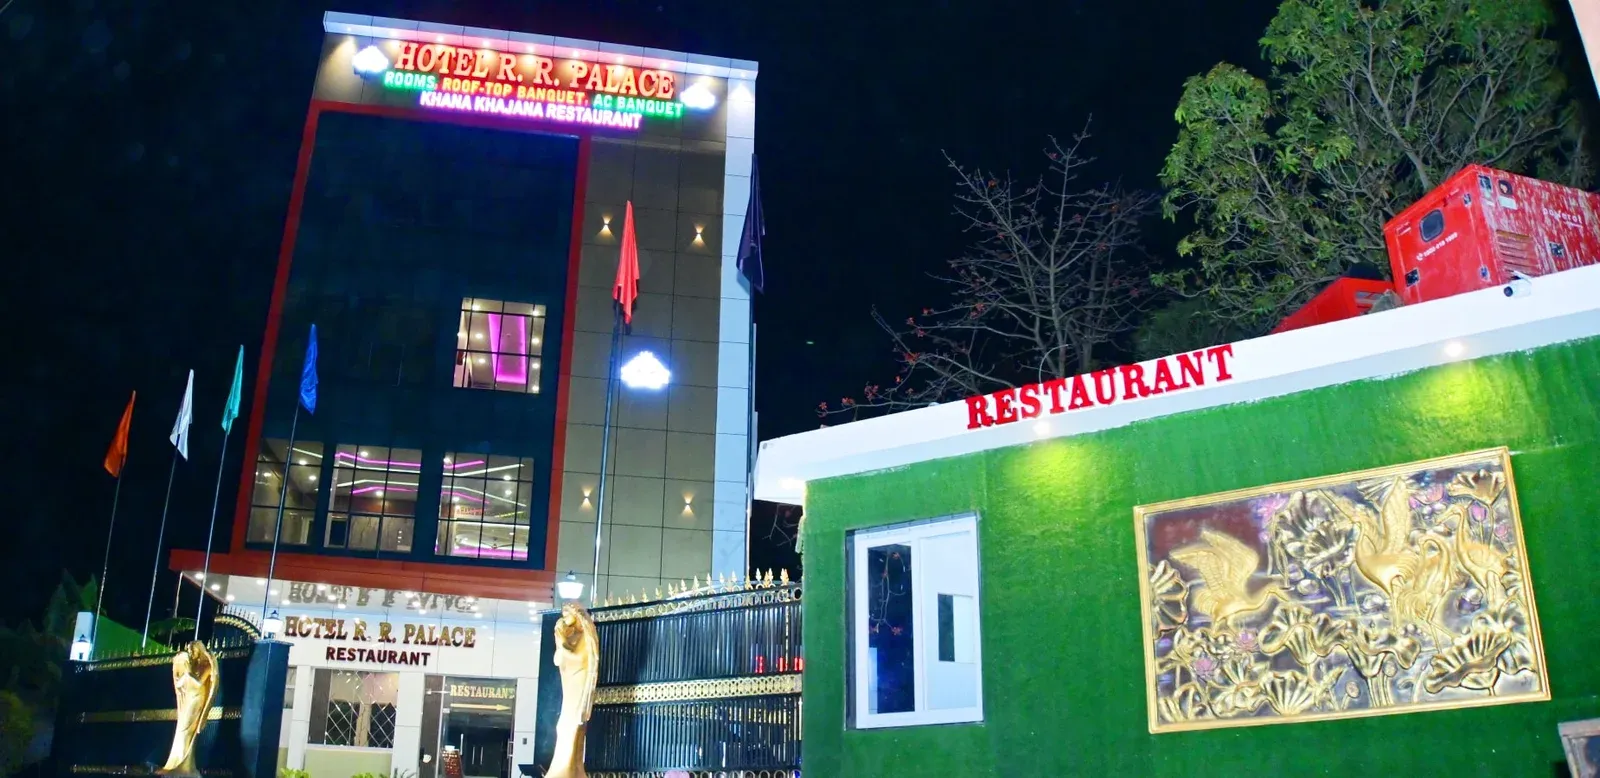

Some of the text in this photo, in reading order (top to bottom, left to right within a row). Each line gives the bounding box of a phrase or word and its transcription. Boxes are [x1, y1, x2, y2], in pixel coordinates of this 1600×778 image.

[394, 41, 675, 99] HOTEL R. R. PALACE
[420, 91, 642, 129] KHANA KHAJANA RESTAURANT
[442, 77, 513, 97] ROOF-TOP
[592, 93, 614, 109] AC
[615, 95, 684, 118] BANQUET
[965, 343, 1234, 430] RESTAURANT
[285, 616, 348, 640] HOTEL
[378, 621, 397, 644] R.
[403, 623, 476, 649] PALACE
[326, 646, 431, 667] RESTAURANT
